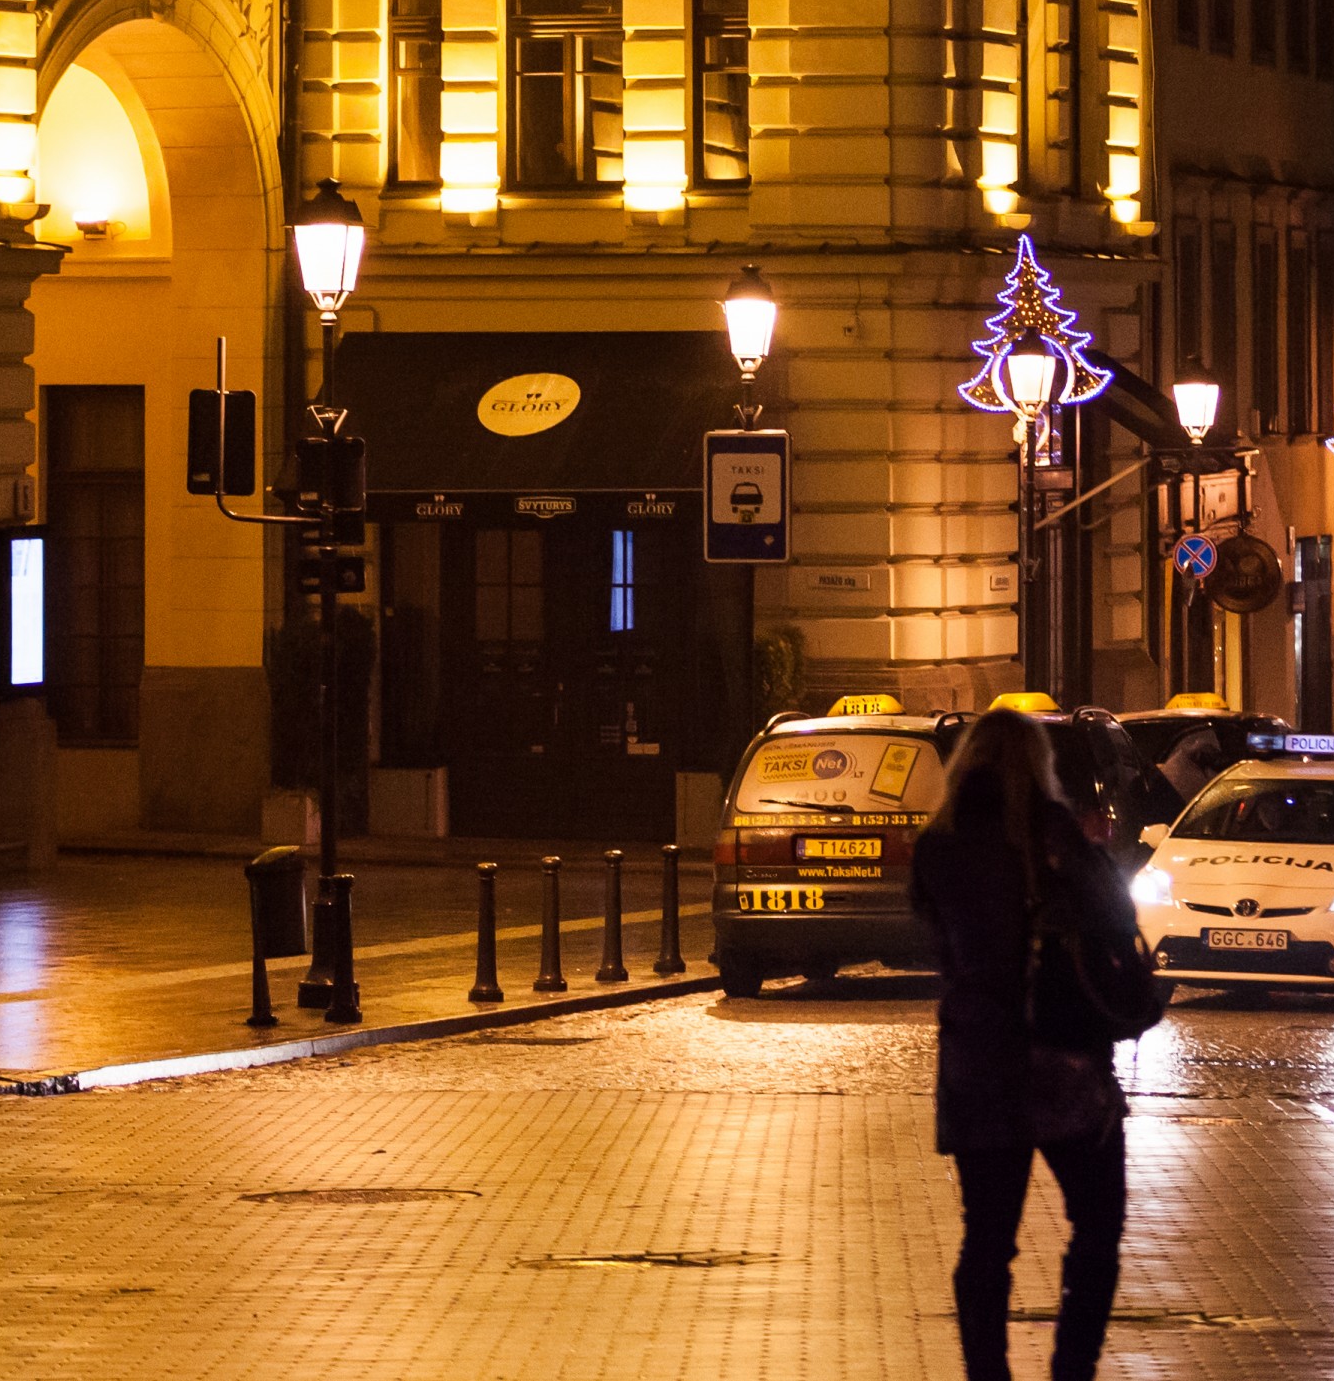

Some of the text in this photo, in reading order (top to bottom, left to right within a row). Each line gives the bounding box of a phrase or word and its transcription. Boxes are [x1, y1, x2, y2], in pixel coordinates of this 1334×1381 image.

[491, 401, 566, 413] GLORY
[731, 465, 765, 475] TAKSI
[416, 505, 463, 516] GLORY
[518, 498, 573, 511] ŠVYTURYS
[627, 503, 675, 516] GLORY
[842, 703, 881, 715] 1818
[763, 758, 807, 774] TAKSI
[815, 757, 843, 770] Net
[818, 840, 876, 856] T14621
[1188, 854, 1334, 873] POLICIJA
[798, 865, 882, 878] www.TaksiNet.lt
[751, 885, 825, 911] 1818
[1210, 931, 1285, 948] GGC 646
